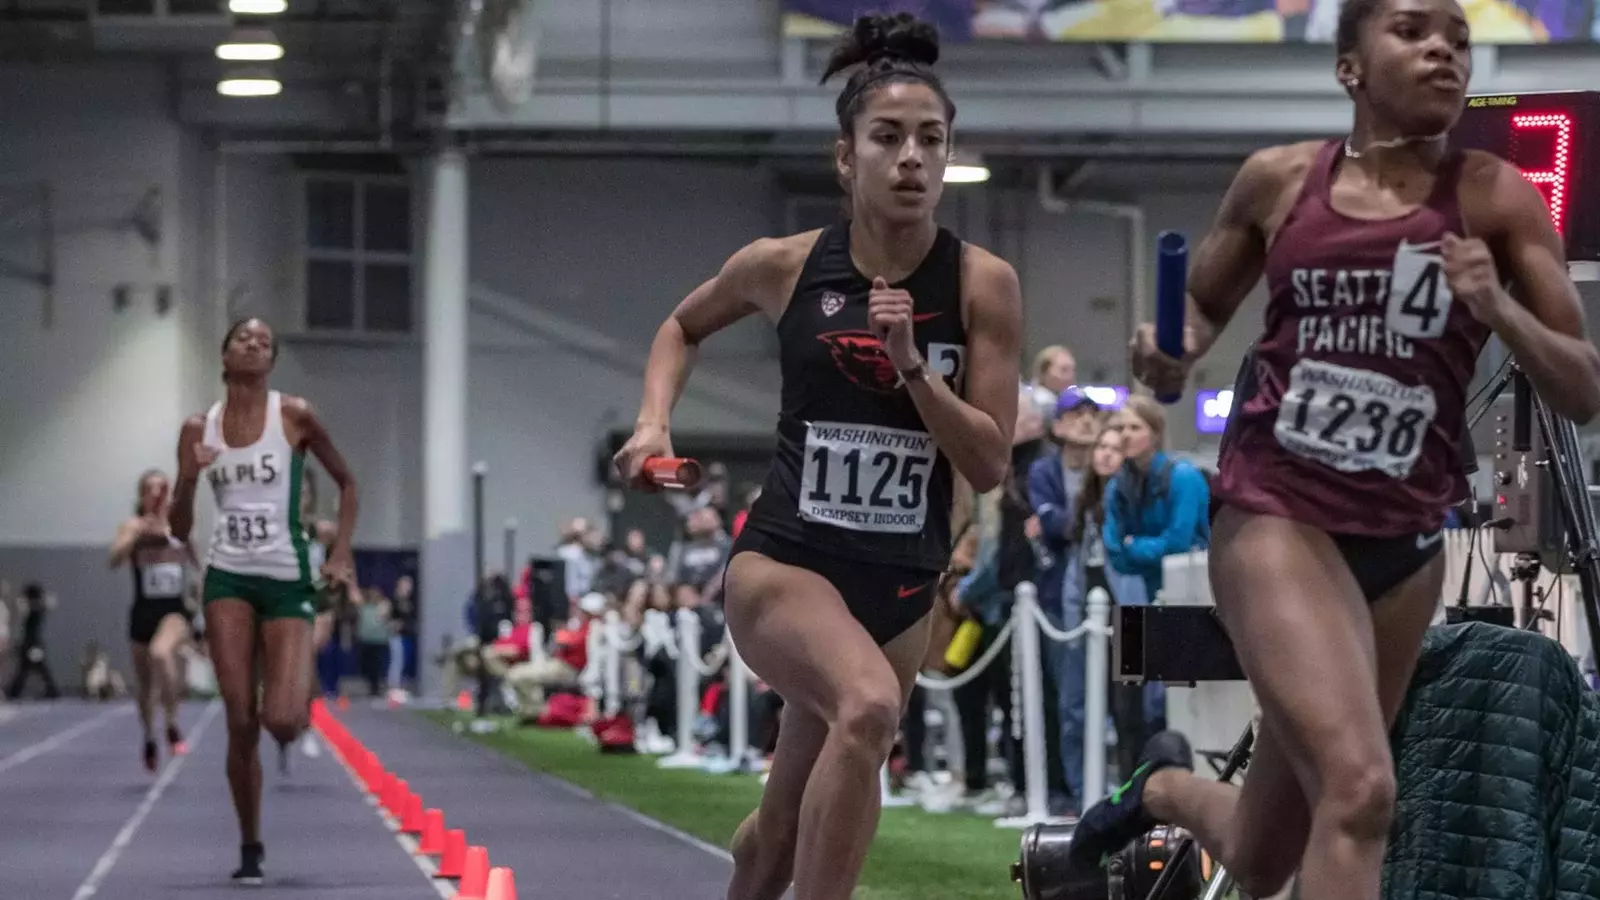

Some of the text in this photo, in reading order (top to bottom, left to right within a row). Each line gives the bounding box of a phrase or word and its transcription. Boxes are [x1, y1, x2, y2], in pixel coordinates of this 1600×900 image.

[1292, 267, 1392, 308] SEATT
[1400, 261, 1441, 332] 4
[813, 427, 932, 451] WASHINGTON
[1286, 388, 1425, 458] 1238
[261, 454, 276, 484] 5
[808, 446, 929, 510] 1125
[227, 514, 267, 542] 833
[811, 506, 916, 526] DEMPSEY INDOOR
